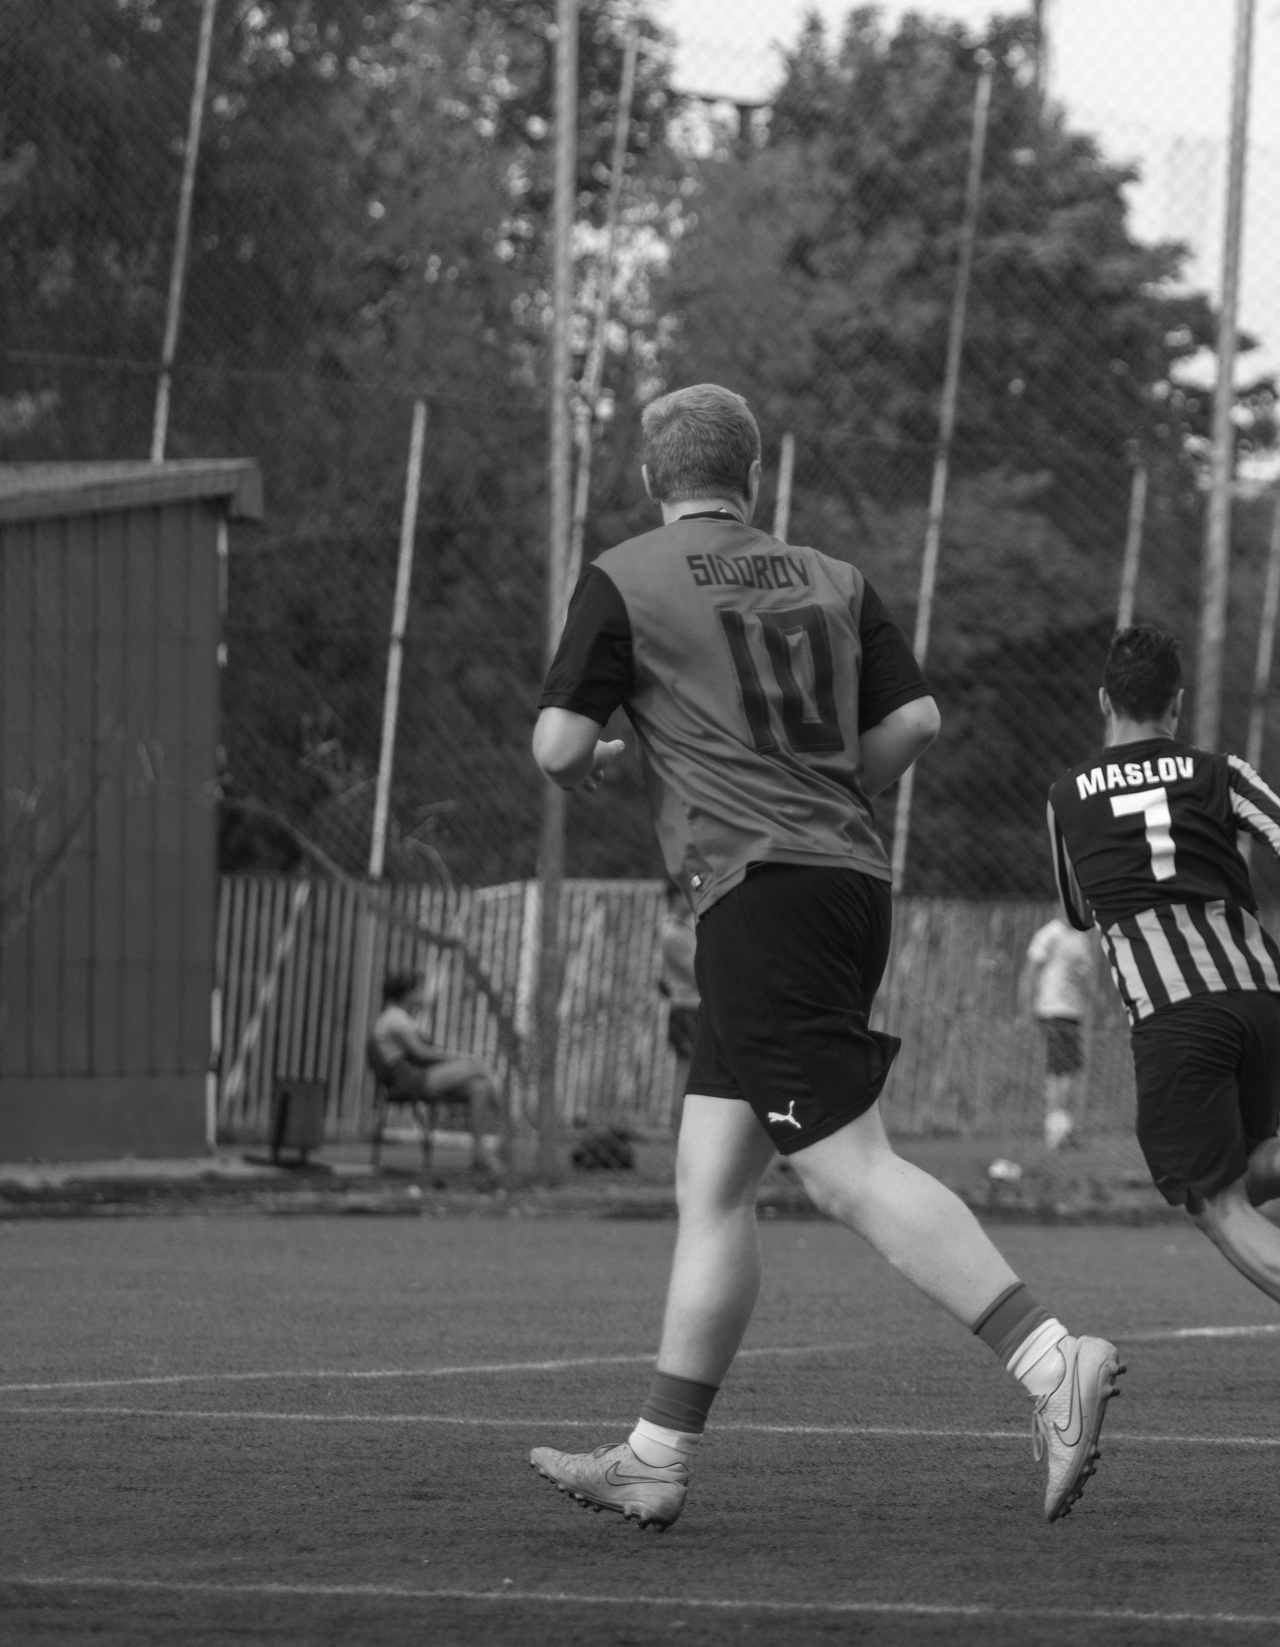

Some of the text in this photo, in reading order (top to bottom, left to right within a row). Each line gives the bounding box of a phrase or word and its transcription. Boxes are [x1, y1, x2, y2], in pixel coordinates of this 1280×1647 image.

[685, 553, 810, 589] SIDOROV
[714, 602, 845, 755] 10
[1075, 756, 1194, 800] MASLOV
[1110, 787, 1177, 882] 7
